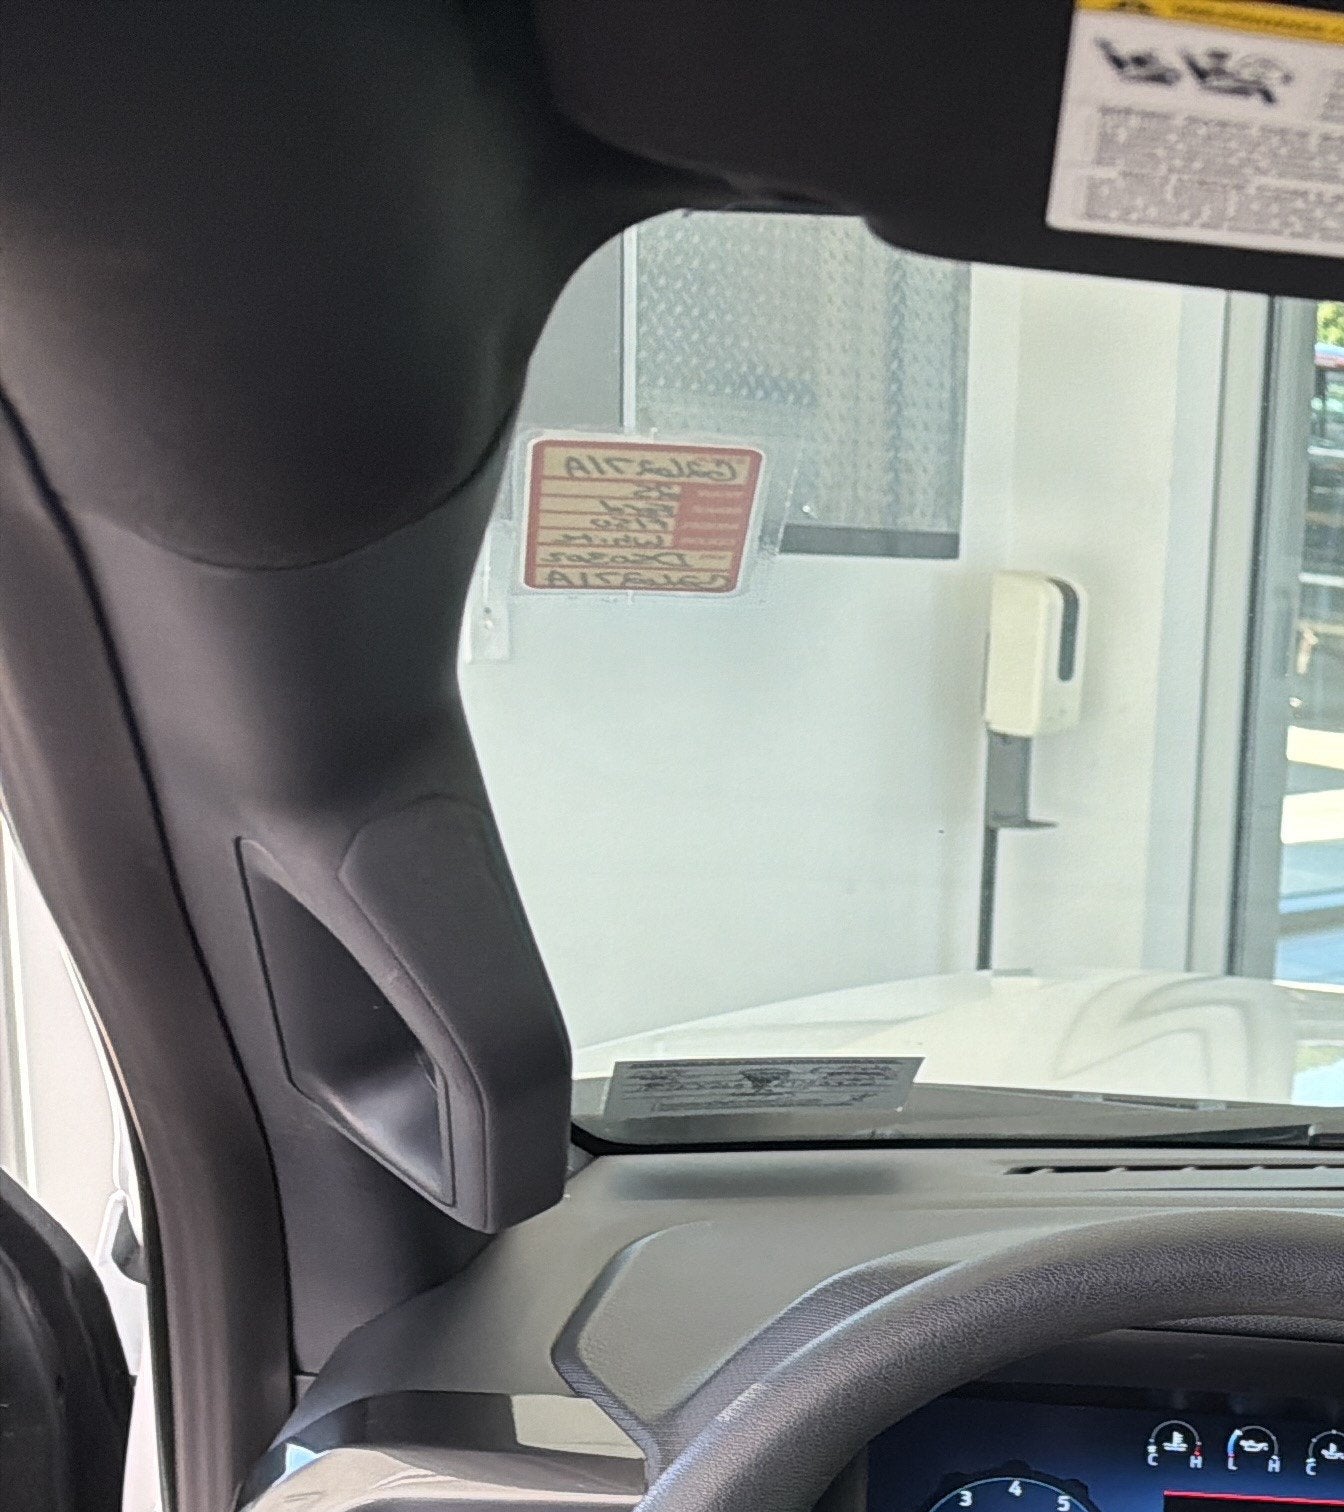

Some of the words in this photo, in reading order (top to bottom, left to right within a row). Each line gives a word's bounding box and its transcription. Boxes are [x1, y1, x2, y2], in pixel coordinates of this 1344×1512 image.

[1148, 1454, 1158, 1466] C
[1190, 1456, 1202, 1469] H
[1228, 1457, 1237, 1471] L
[1267, 1459, 1281, 1473] H
[1306, 1461, 1316, 1476] C
[1008, 1480, 1023, 1498] 4
[958, 1490, 973, 1507] 3
[1056, 1495, 1071, 1512] 5
